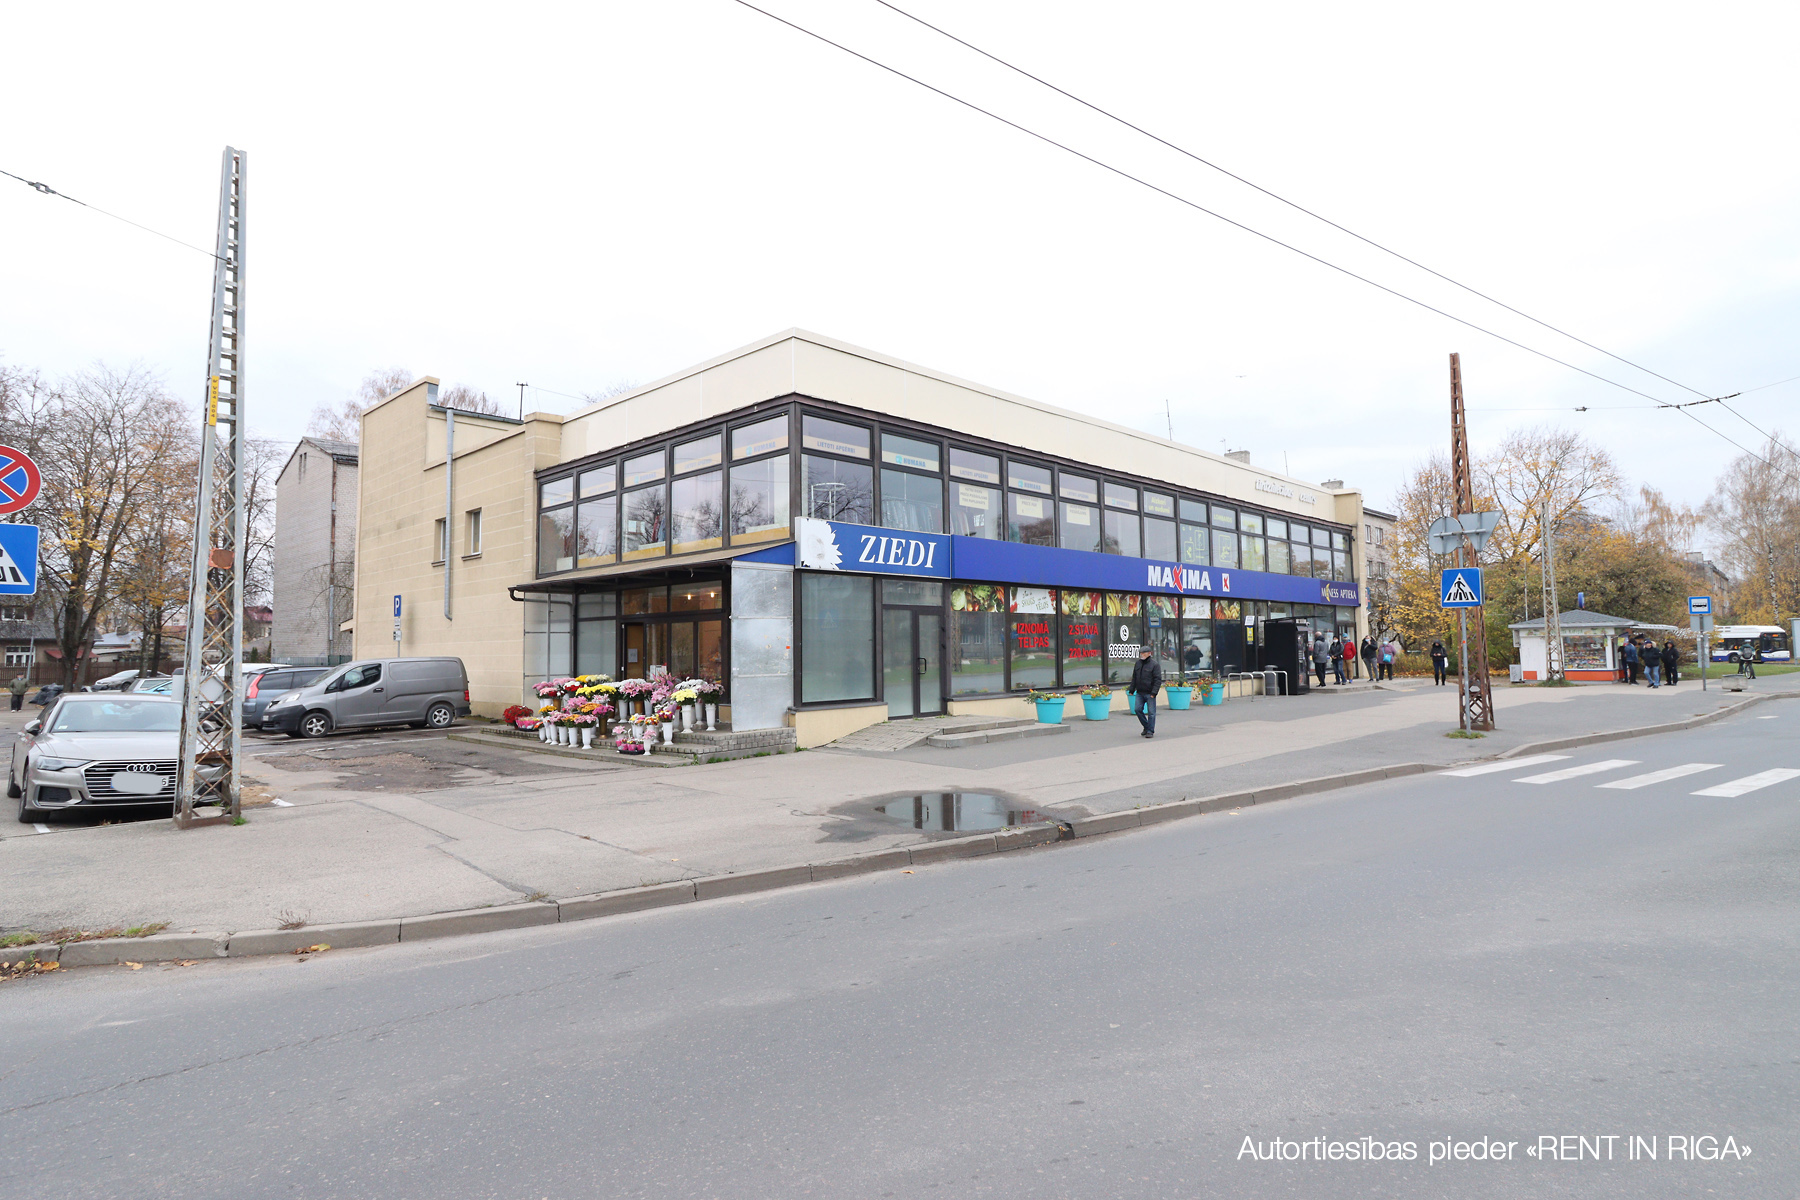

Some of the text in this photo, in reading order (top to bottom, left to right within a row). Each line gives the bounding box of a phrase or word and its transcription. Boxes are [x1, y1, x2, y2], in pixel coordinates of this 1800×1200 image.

[903, 458, 926, 467] HUMANA
[858, 535, 937, 568] ZIEDI
[1148, 564, 1211, 592] MAXIMA
[1017, 621, 1050, 634] IZNOMĀ
[1018, 636, 1050, 648] TELPAS
